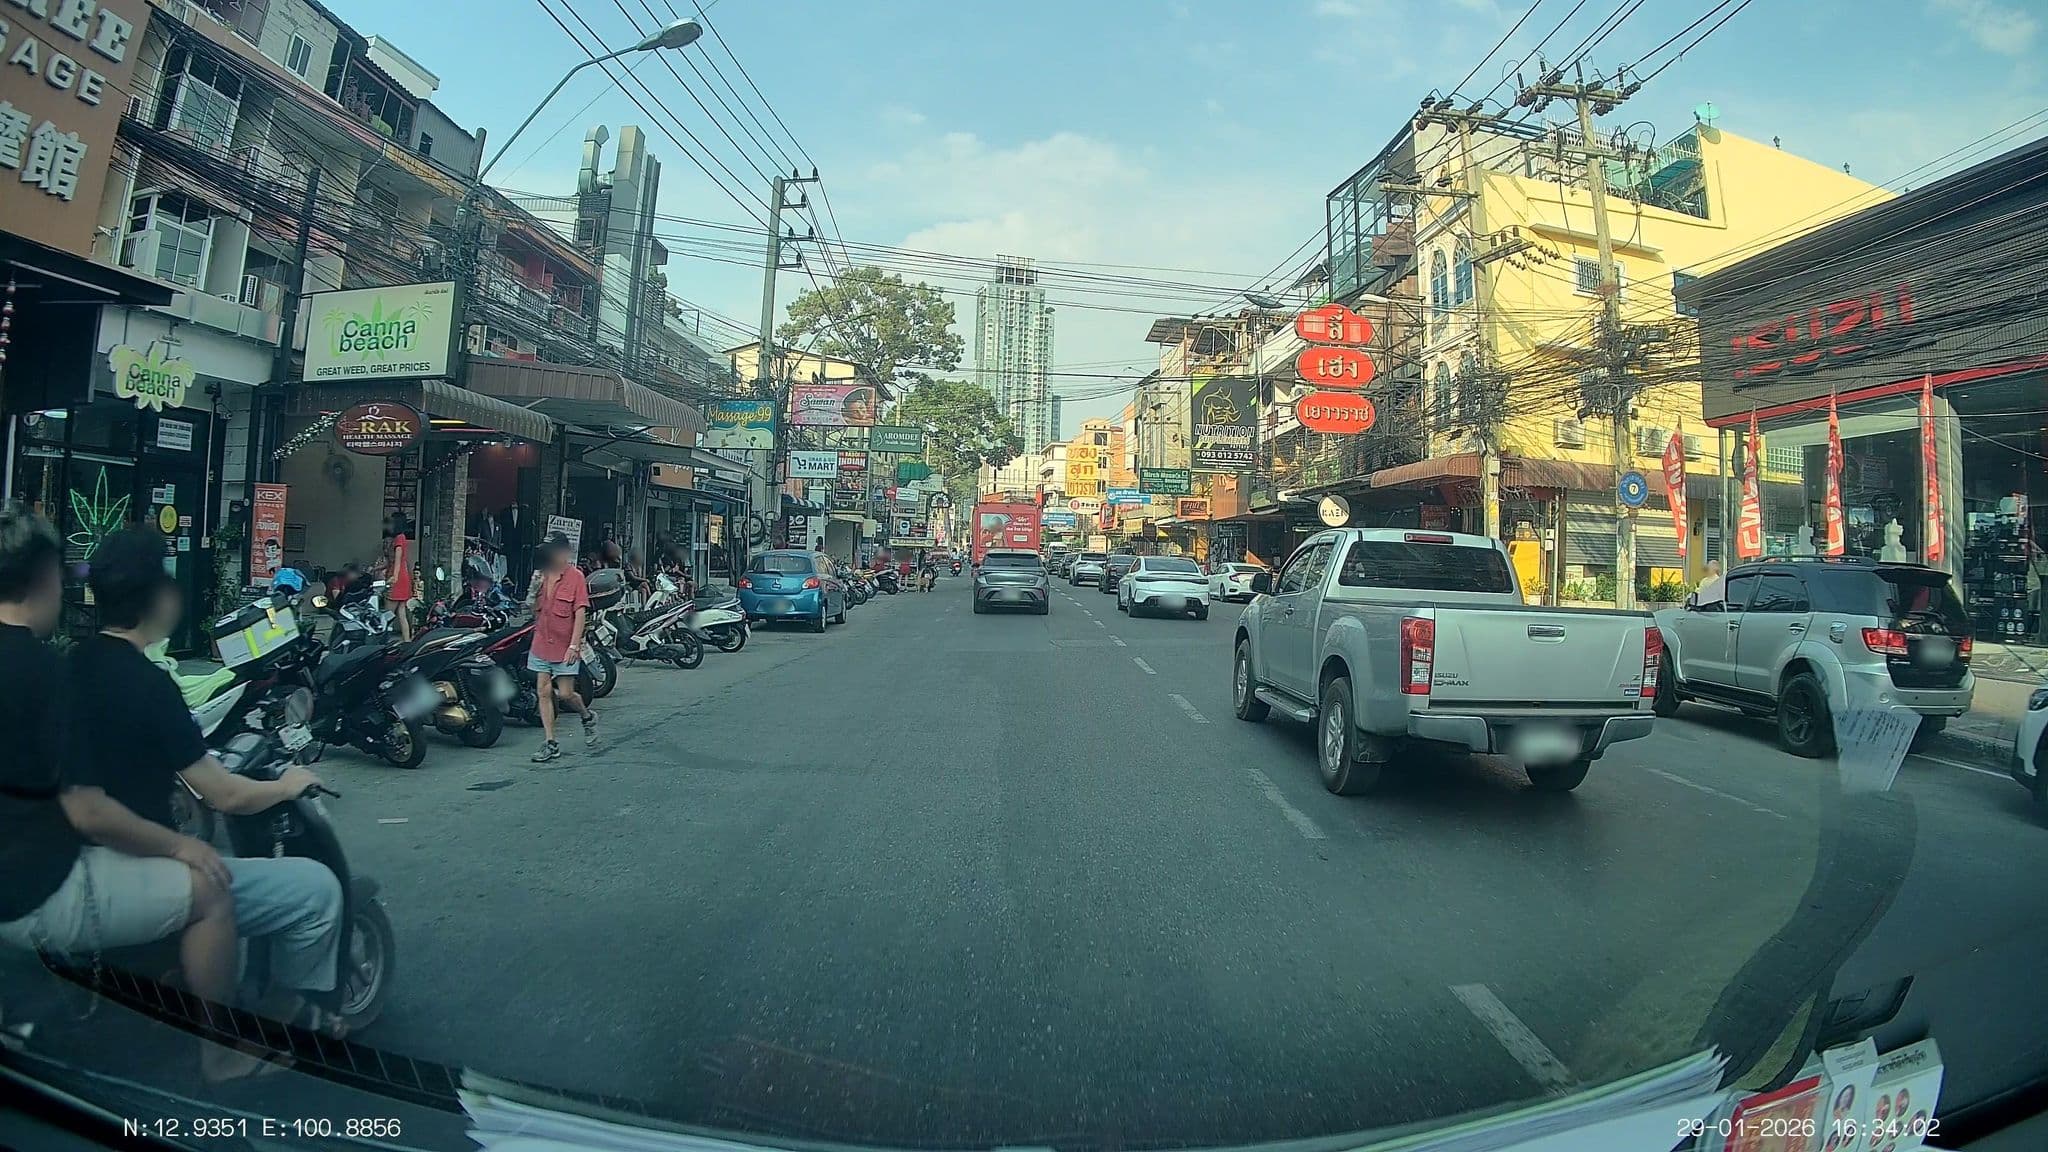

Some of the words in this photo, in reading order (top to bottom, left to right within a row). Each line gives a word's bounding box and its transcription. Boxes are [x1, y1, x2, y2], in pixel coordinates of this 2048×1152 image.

[343, 319, 416, 338] Canna
[339, 335, 408, 353] beach
[129, 363, 180, 387] Canna
[316, 367, 341, 376] GREAT
[343, 366, 368, 375] WEED,
[370, 364, 397, 374] GREAT
[399, 362, 431, 371] PRICES
[125, 377, 175, 399] beach
[708, 404, 756, 426] Massage
[757, 406, 772, 421] 99
[360, 421, 412, 433] RAK
[1194, 423, 1255, 438] NUTRITION
[884, 432, 919, 441] AROMDEE
[1217, 451, 1232, 459] 012
[1233, 452, 1254, 460] 5742
[808, 463, 835, 471] MART
[257, 491, 283, 500] KEX
